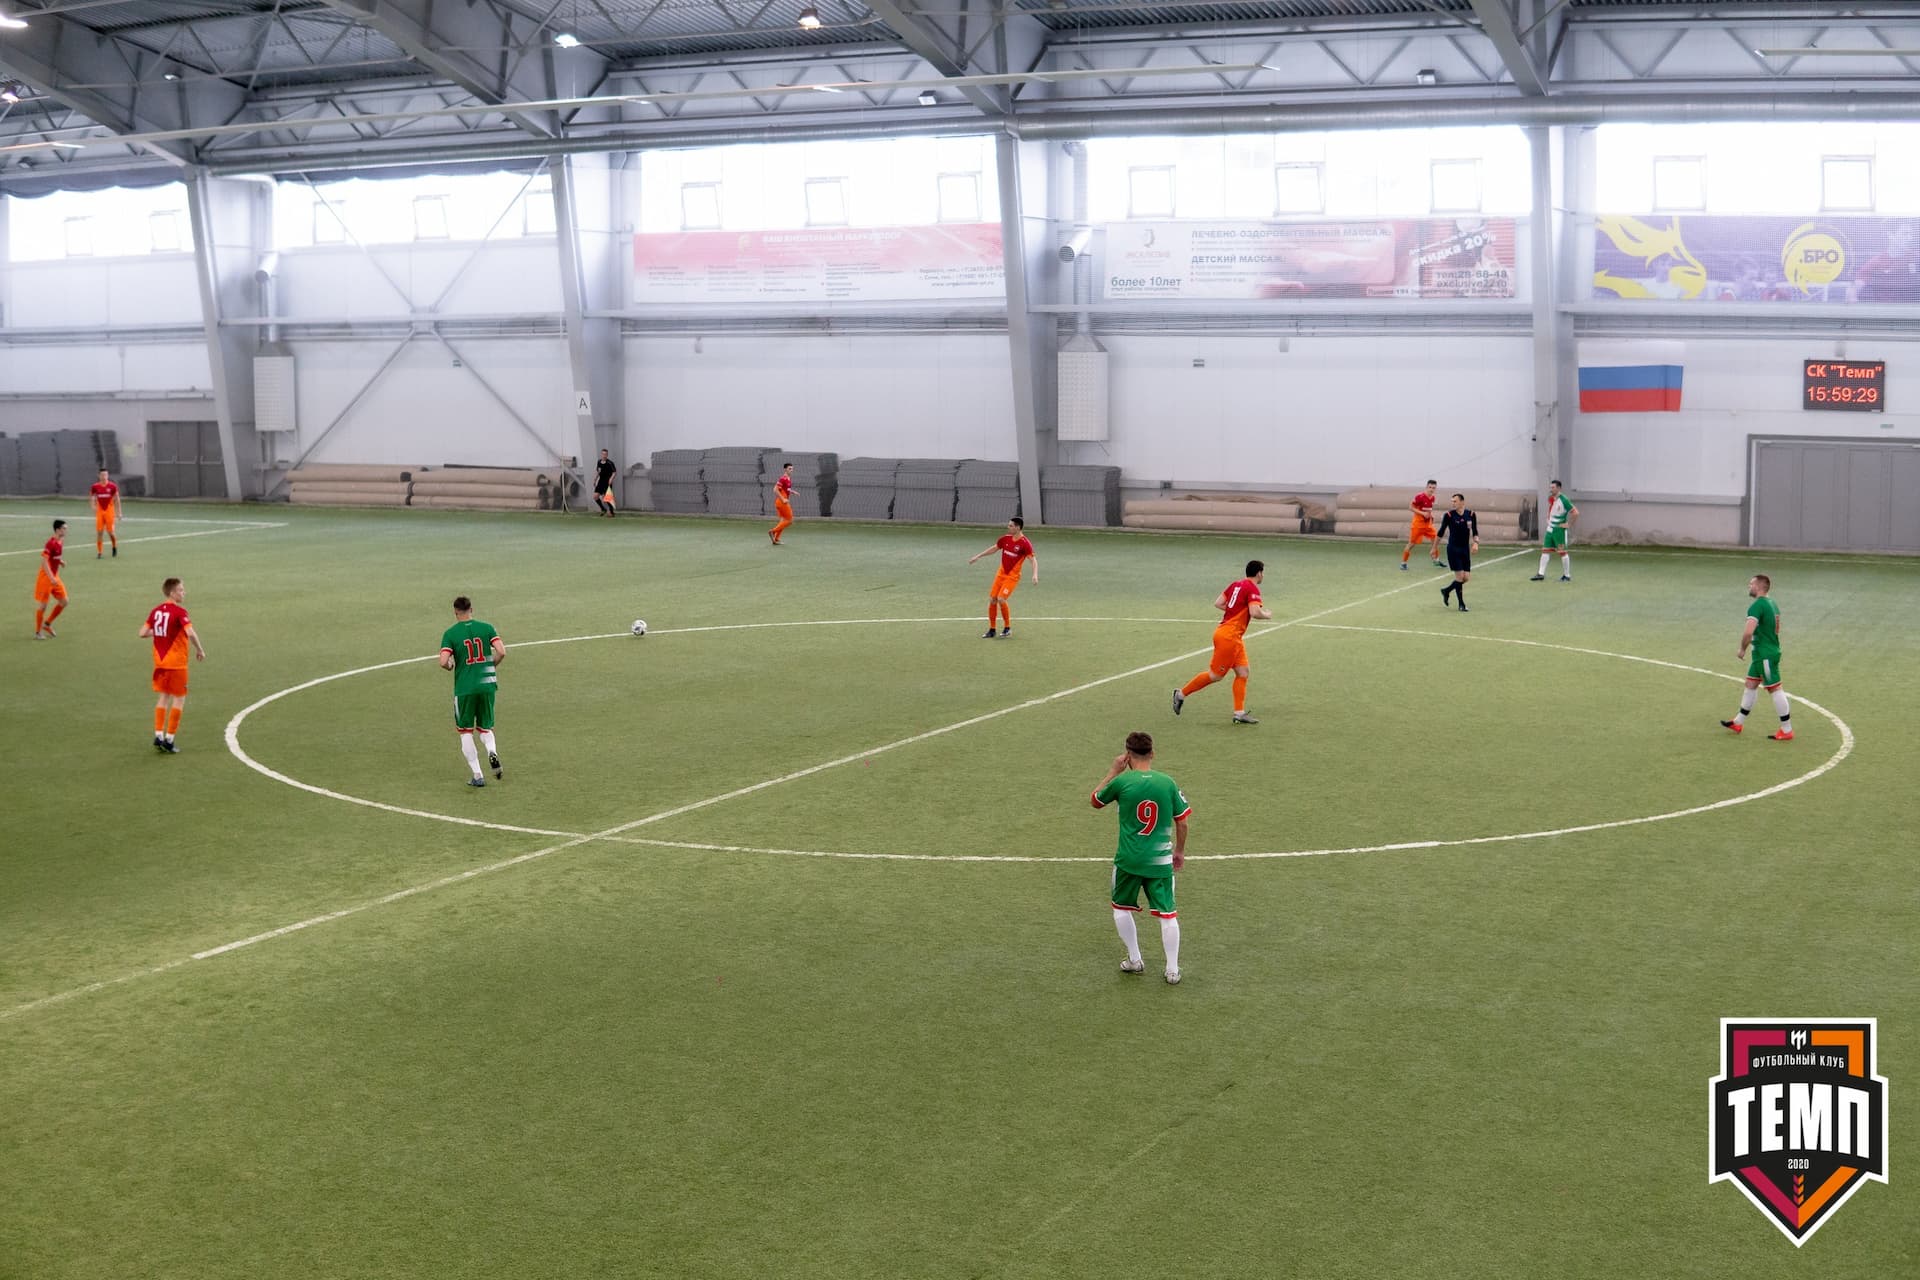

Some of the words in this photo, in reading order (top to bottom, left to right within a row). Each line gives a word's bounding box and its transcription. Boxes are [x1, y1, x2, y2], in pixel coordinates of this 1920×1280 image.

[1111, 276, 1146, 287] более
[1807, 364, 1828, 378] СК
[1830, 365, 1883, 379] "Темп"
[1807, 386, 1878, 403] 15:59:29
[464, 637, 486, 665] 11
[1136, 800, 1159, 836] 9
